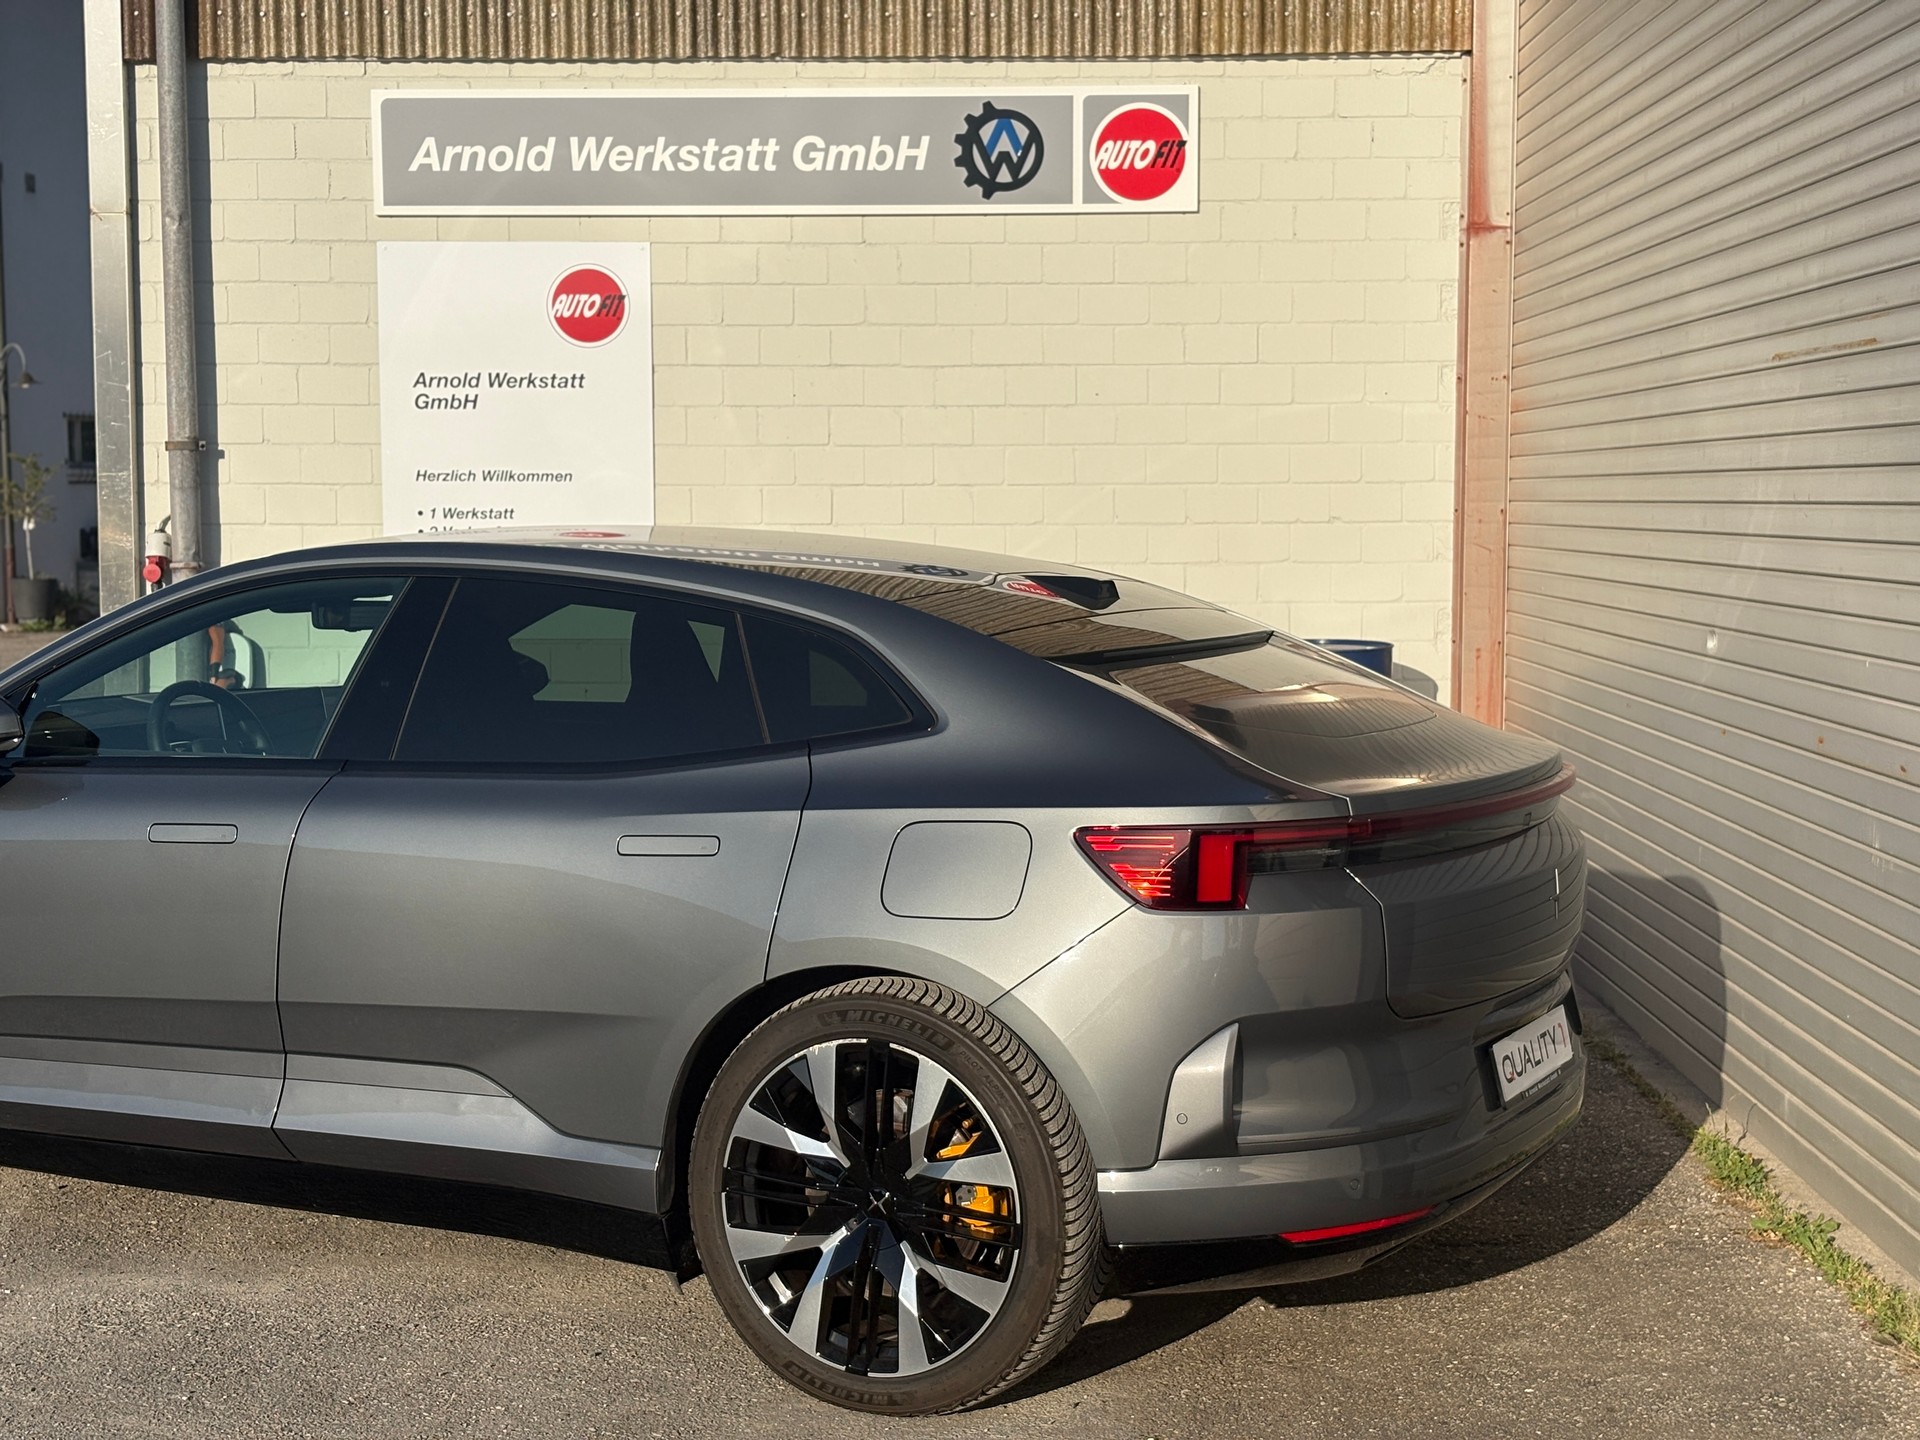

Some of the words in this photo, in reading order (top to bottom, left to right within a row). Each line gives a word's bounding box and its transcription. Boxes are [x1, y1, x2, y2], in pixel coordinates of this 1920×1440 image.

[407, 136, 557, 173] Arnold
[569, 136, 781, 173] Werkstatt
[792, 135, 931, 172] GmbH
[1095, 139, 1188, 170] AUTOFIT
[552, 293, 627, 319] AUTOFIT
[412, 371, 481, 389] Arnold
[487, 372, 586, 389] Werkstatt
[413, 392, 479, 410] GmbH
[415, 469, 477, 482] Herzlich
[481, 469, 573, 483] Willkommen
[430, 507, 437, 520] 1
[442, 507, 515, 520] Werkstatt
[845, 1009, 950, 1049] MICHELIN
[959, 1049, 984, 1073] PILOT
[1501, 1025, 1558, 1084] QUALITY
[1557, 1022, 1567, 1049] 1
